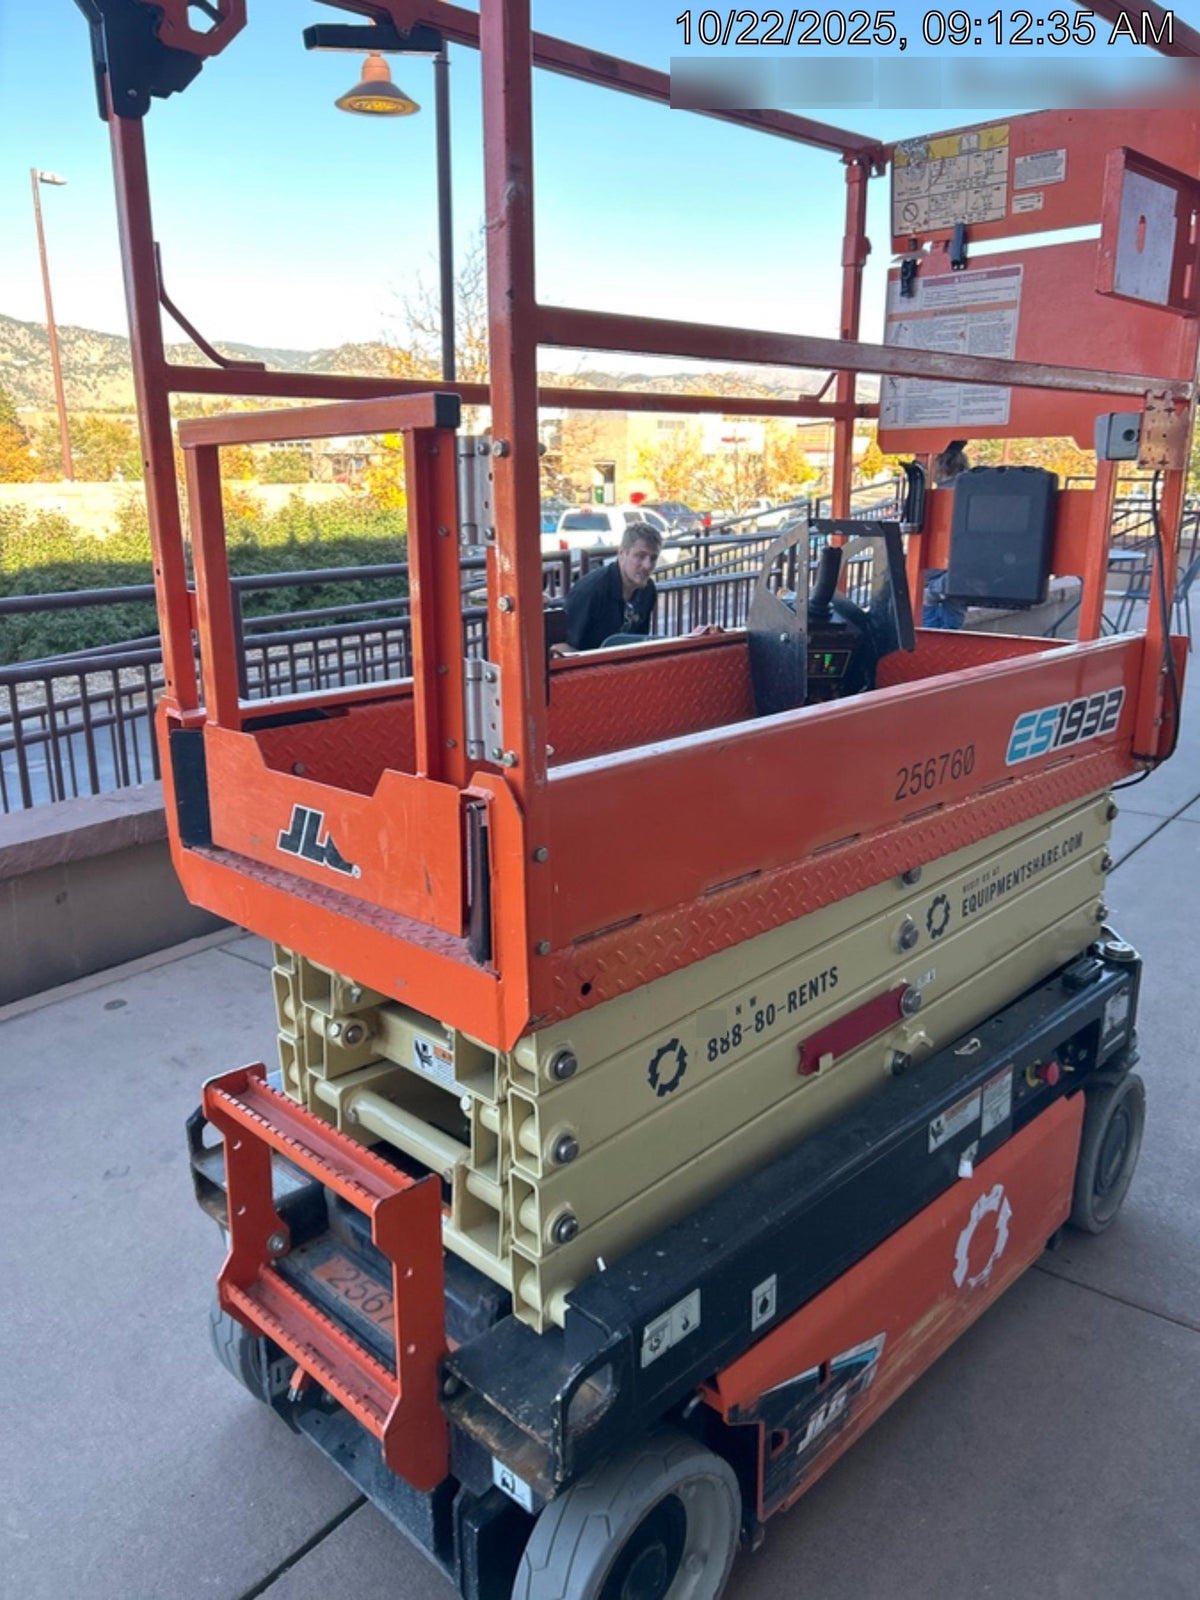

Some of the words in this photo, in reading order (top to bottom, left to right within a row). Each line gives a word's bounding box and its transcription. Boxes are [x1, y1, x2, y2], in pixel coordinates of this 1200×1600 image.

[1007, 687, 1125, 764] ES1932
[894, 744, 976, 802] 256760
[961, 831, 1084, 918] EQUIPMENTSHARE.COM
[706, 965, 839, 1062] 888-80-RENTS
